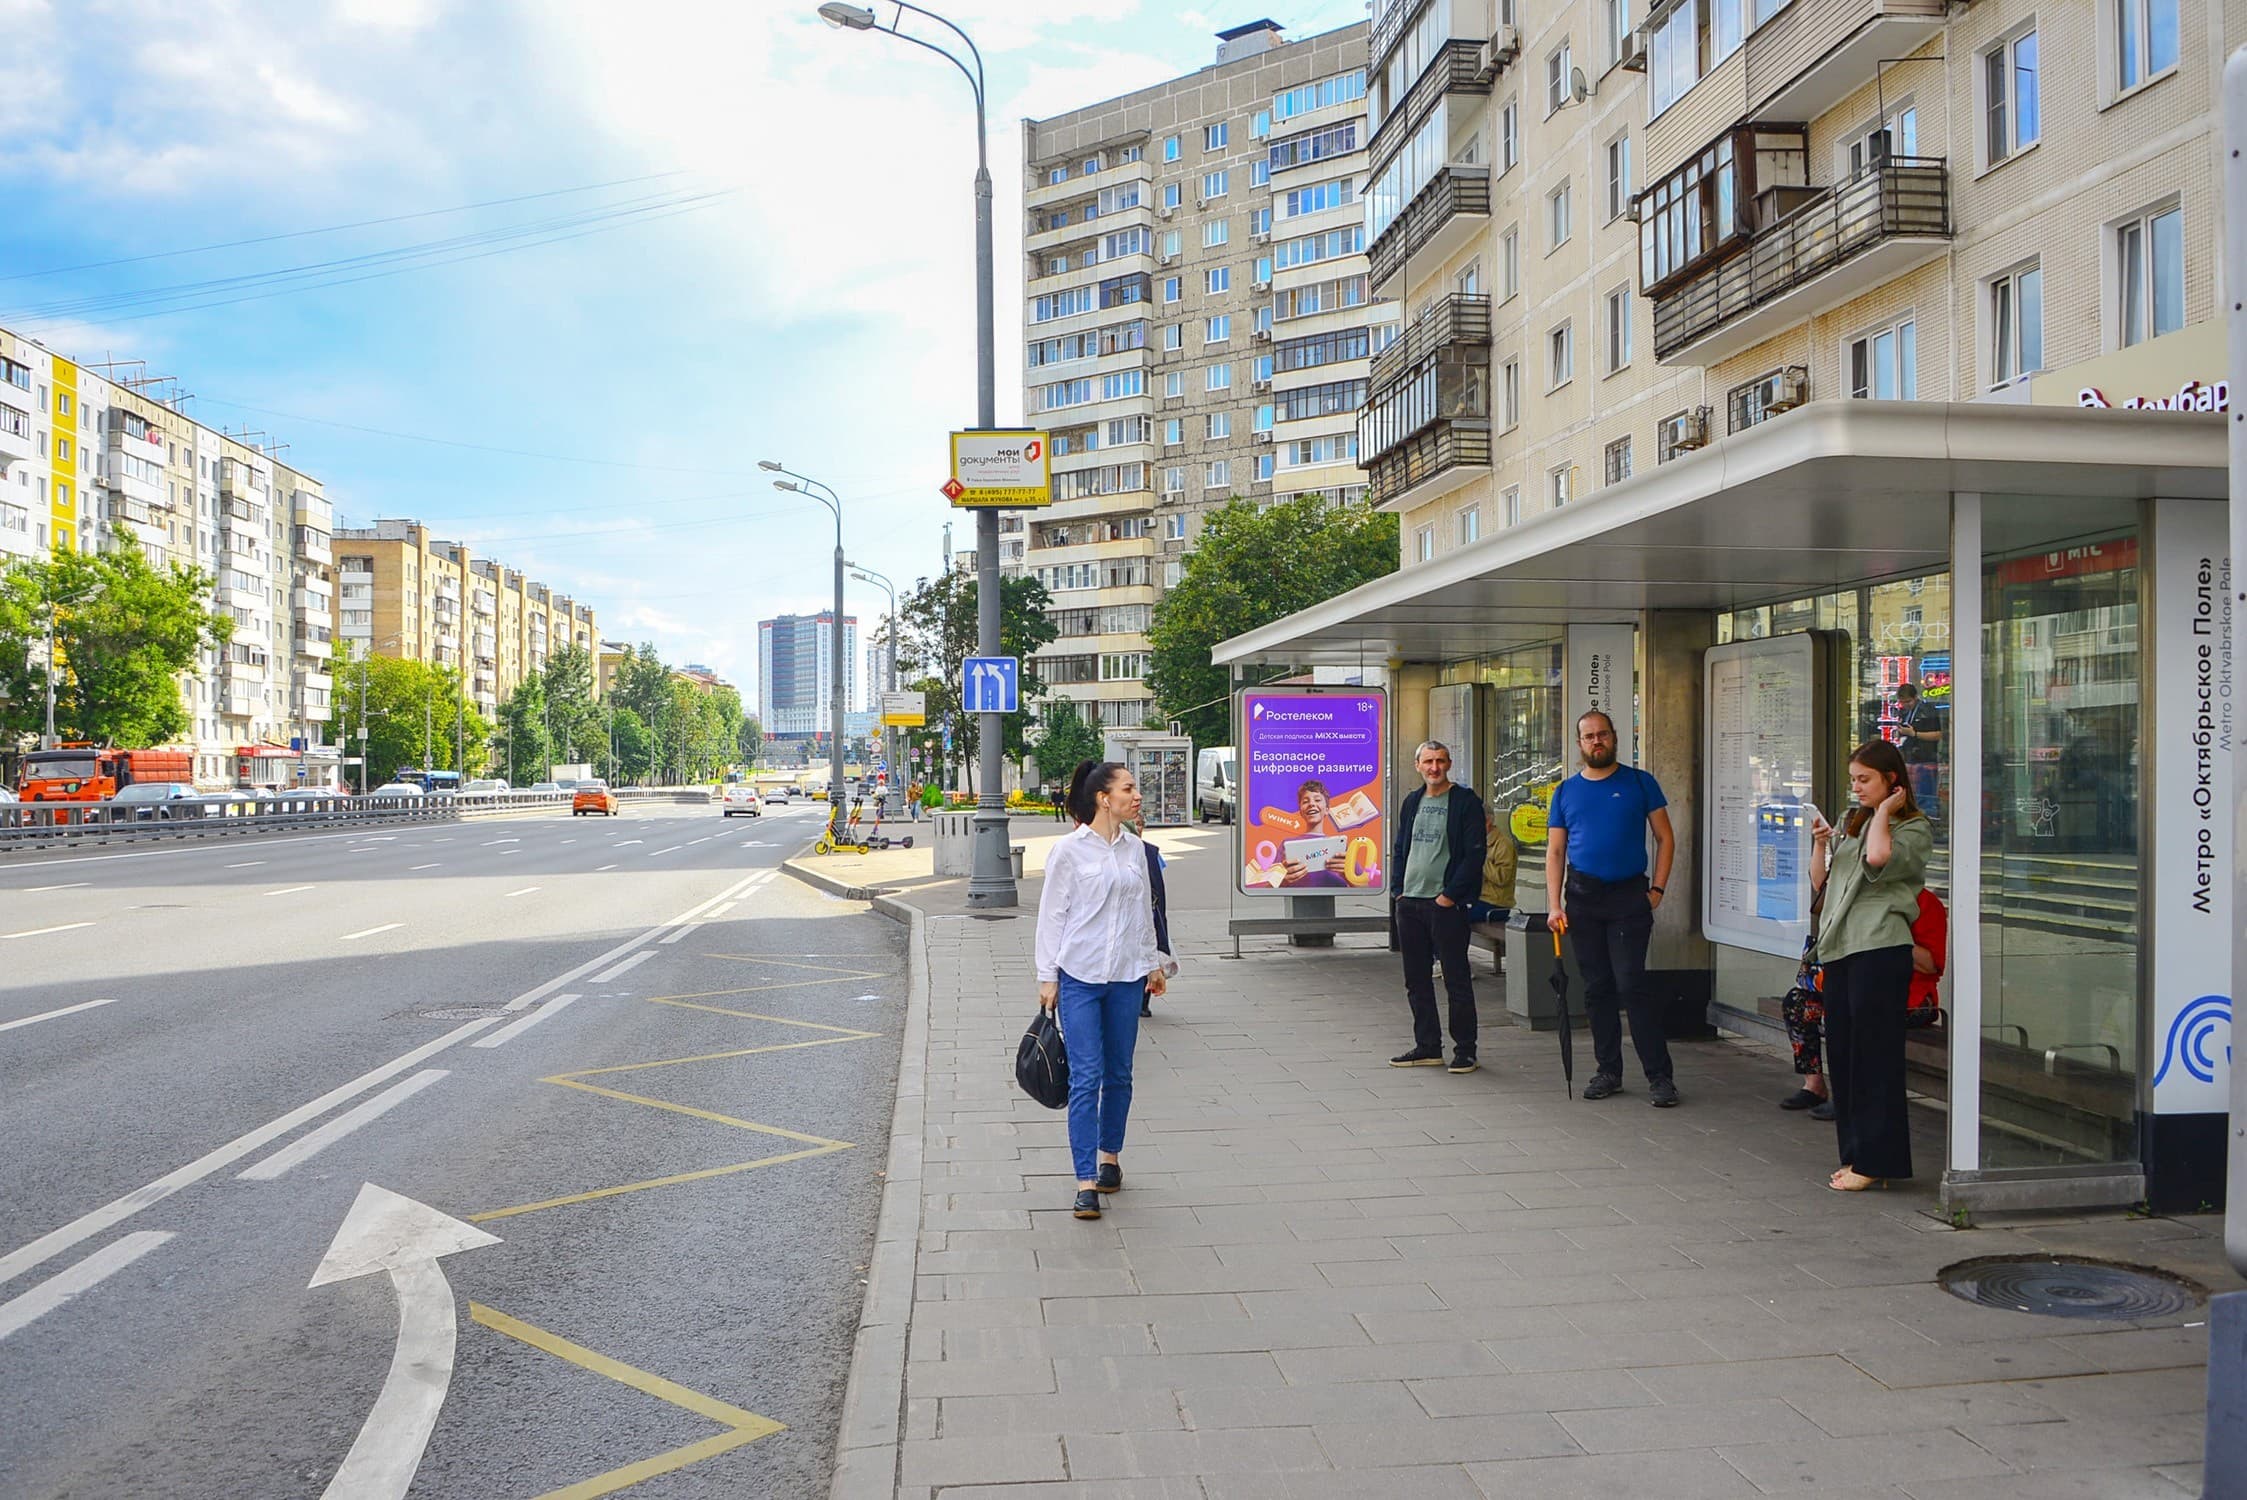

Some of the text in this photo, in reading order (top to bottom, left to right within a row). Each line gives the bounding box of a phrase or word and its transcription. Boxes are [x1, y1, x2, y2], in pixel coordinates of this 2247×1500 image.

[960, 457, 1020, 466] документы
[2219, 557, 2232, 590] Pole
[1588, 654, 1600, 695] Поле»
[1357, 702, 1374, 712] 18+
[1266, 710, 1333, 720] Ростелеком
[2219, 702, 2232, 751] Metro
[1284, 733, 1313, 741] подписка
[2192, 557, 2215, 914] Метро «Октябрьское Поле»
[1253, 750, 1326, 761] Безопасное
[1253, 763, 1373, 774] цифровое развитие
